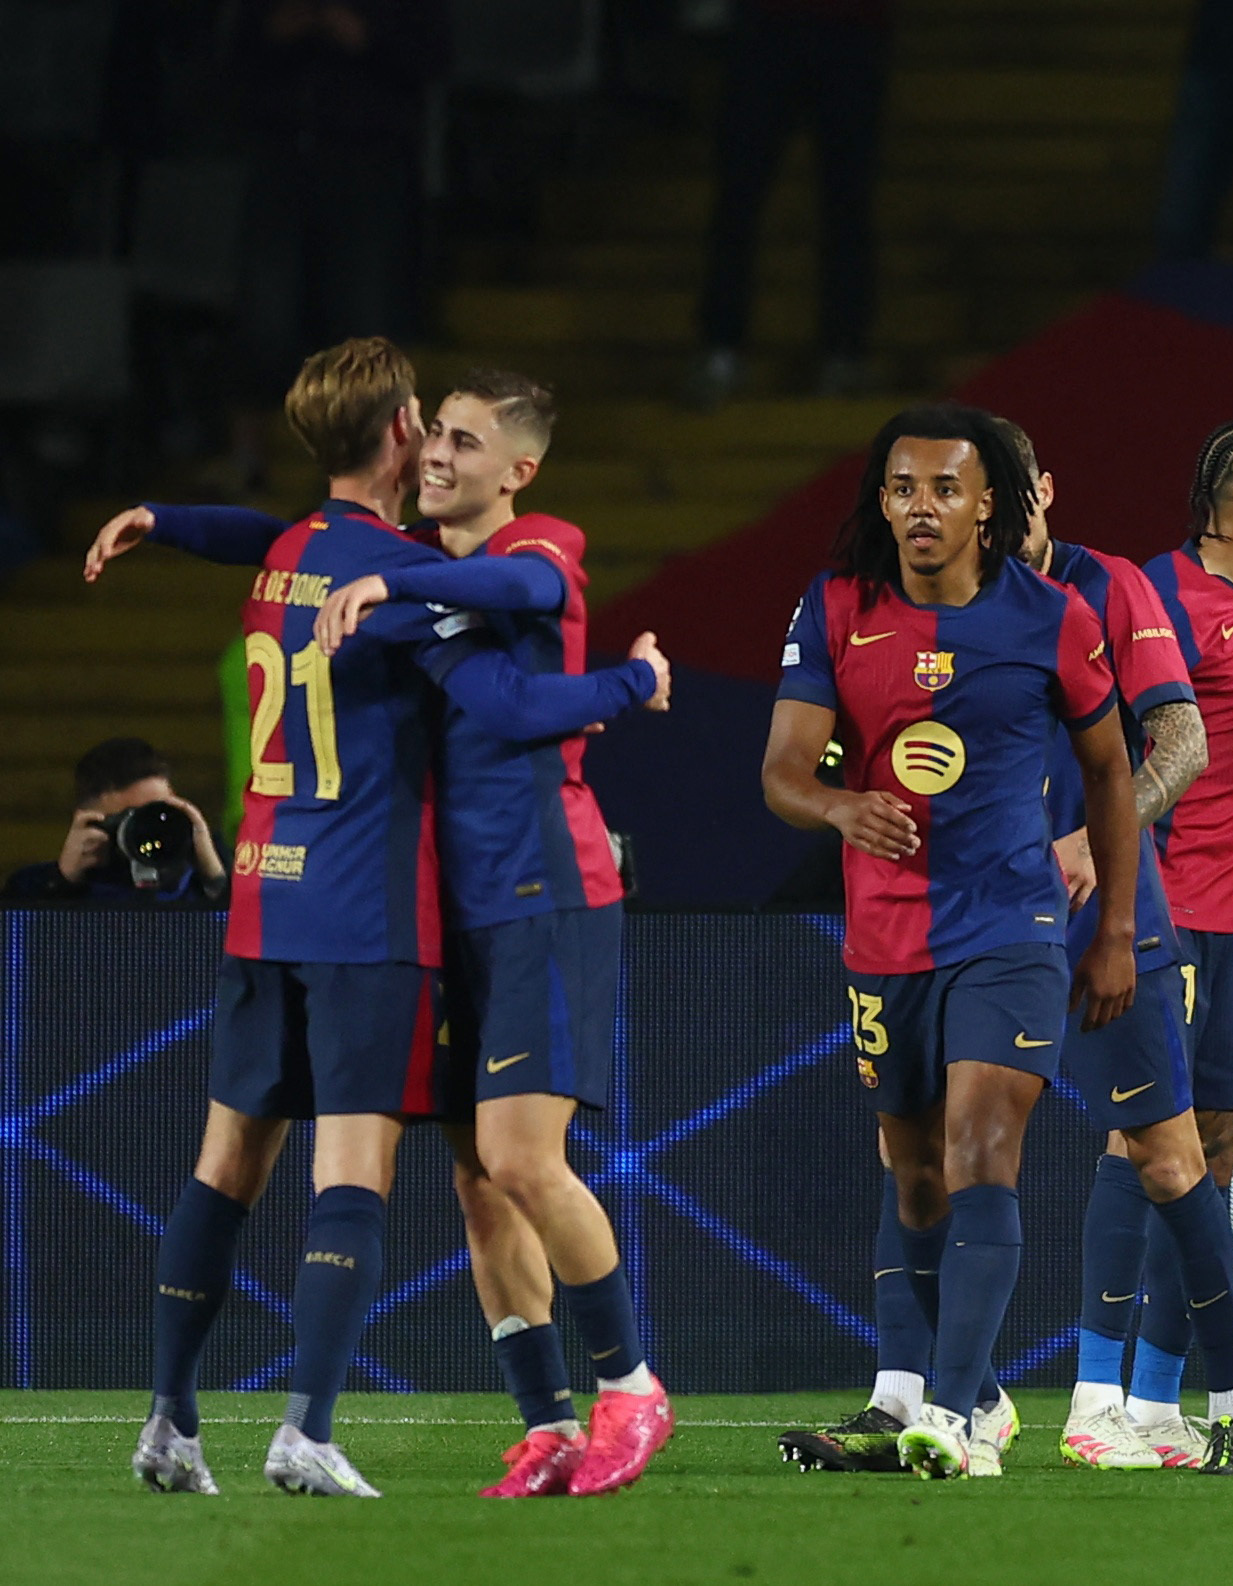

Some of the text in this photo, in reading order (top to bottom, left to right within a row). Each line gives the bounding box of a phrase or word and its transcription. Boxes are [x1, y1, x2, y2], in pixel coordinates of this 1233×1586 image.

[285, 572, 333, 608] JONG
[244, 631, 342, 801] 21
[847, 985, 889, 1055] 13
